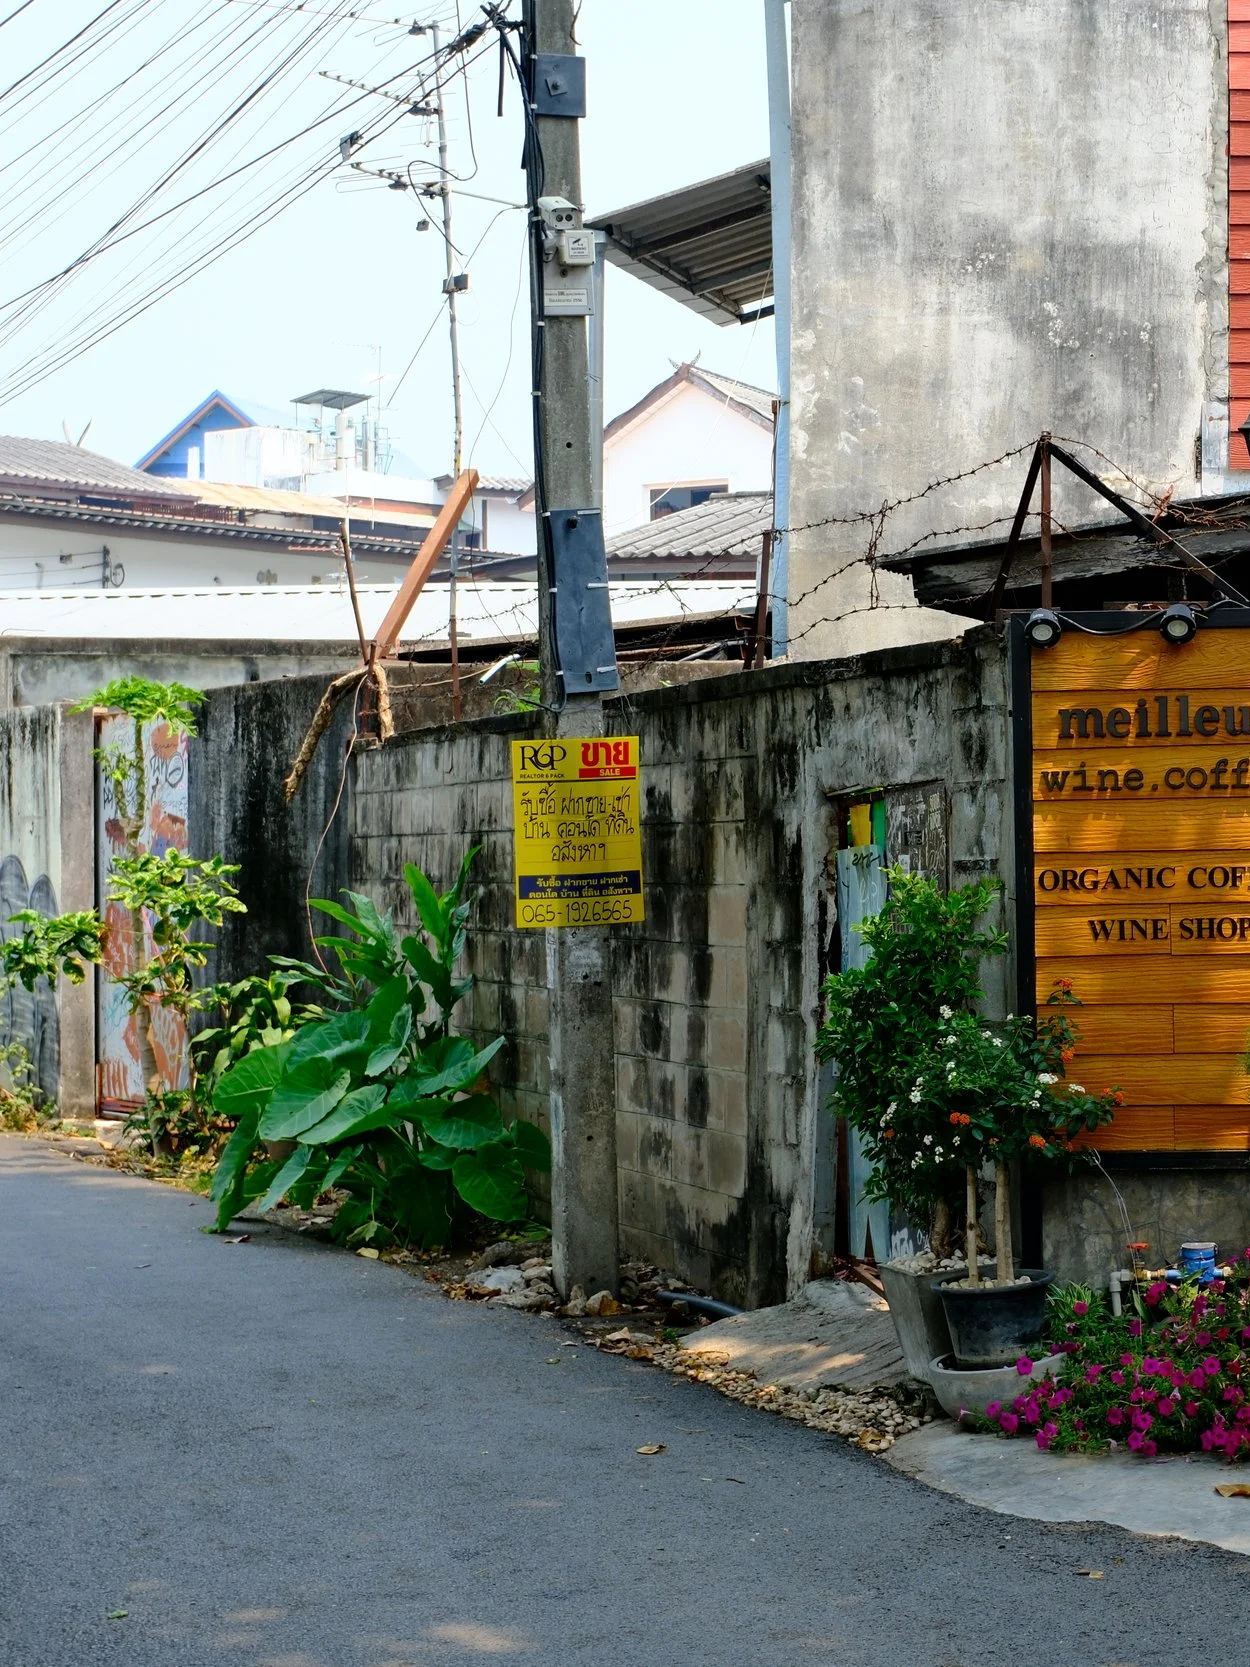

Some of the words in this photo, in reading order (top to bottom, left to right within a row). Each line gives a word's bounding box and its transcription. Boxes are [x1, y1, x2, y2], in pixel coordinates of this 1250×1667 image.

[581, 741, 630, 767] ขาย
[600, 768, 620, 776] SALE
[524, 815, 551, 839] บ้าน
[557, 814, 601, 838] คอนโด
[1038, 867, 1176, 892] ORGANIC
[522, 899, 633, 923] 065-1926565
[1088, 918, 1169, 943] WINE
